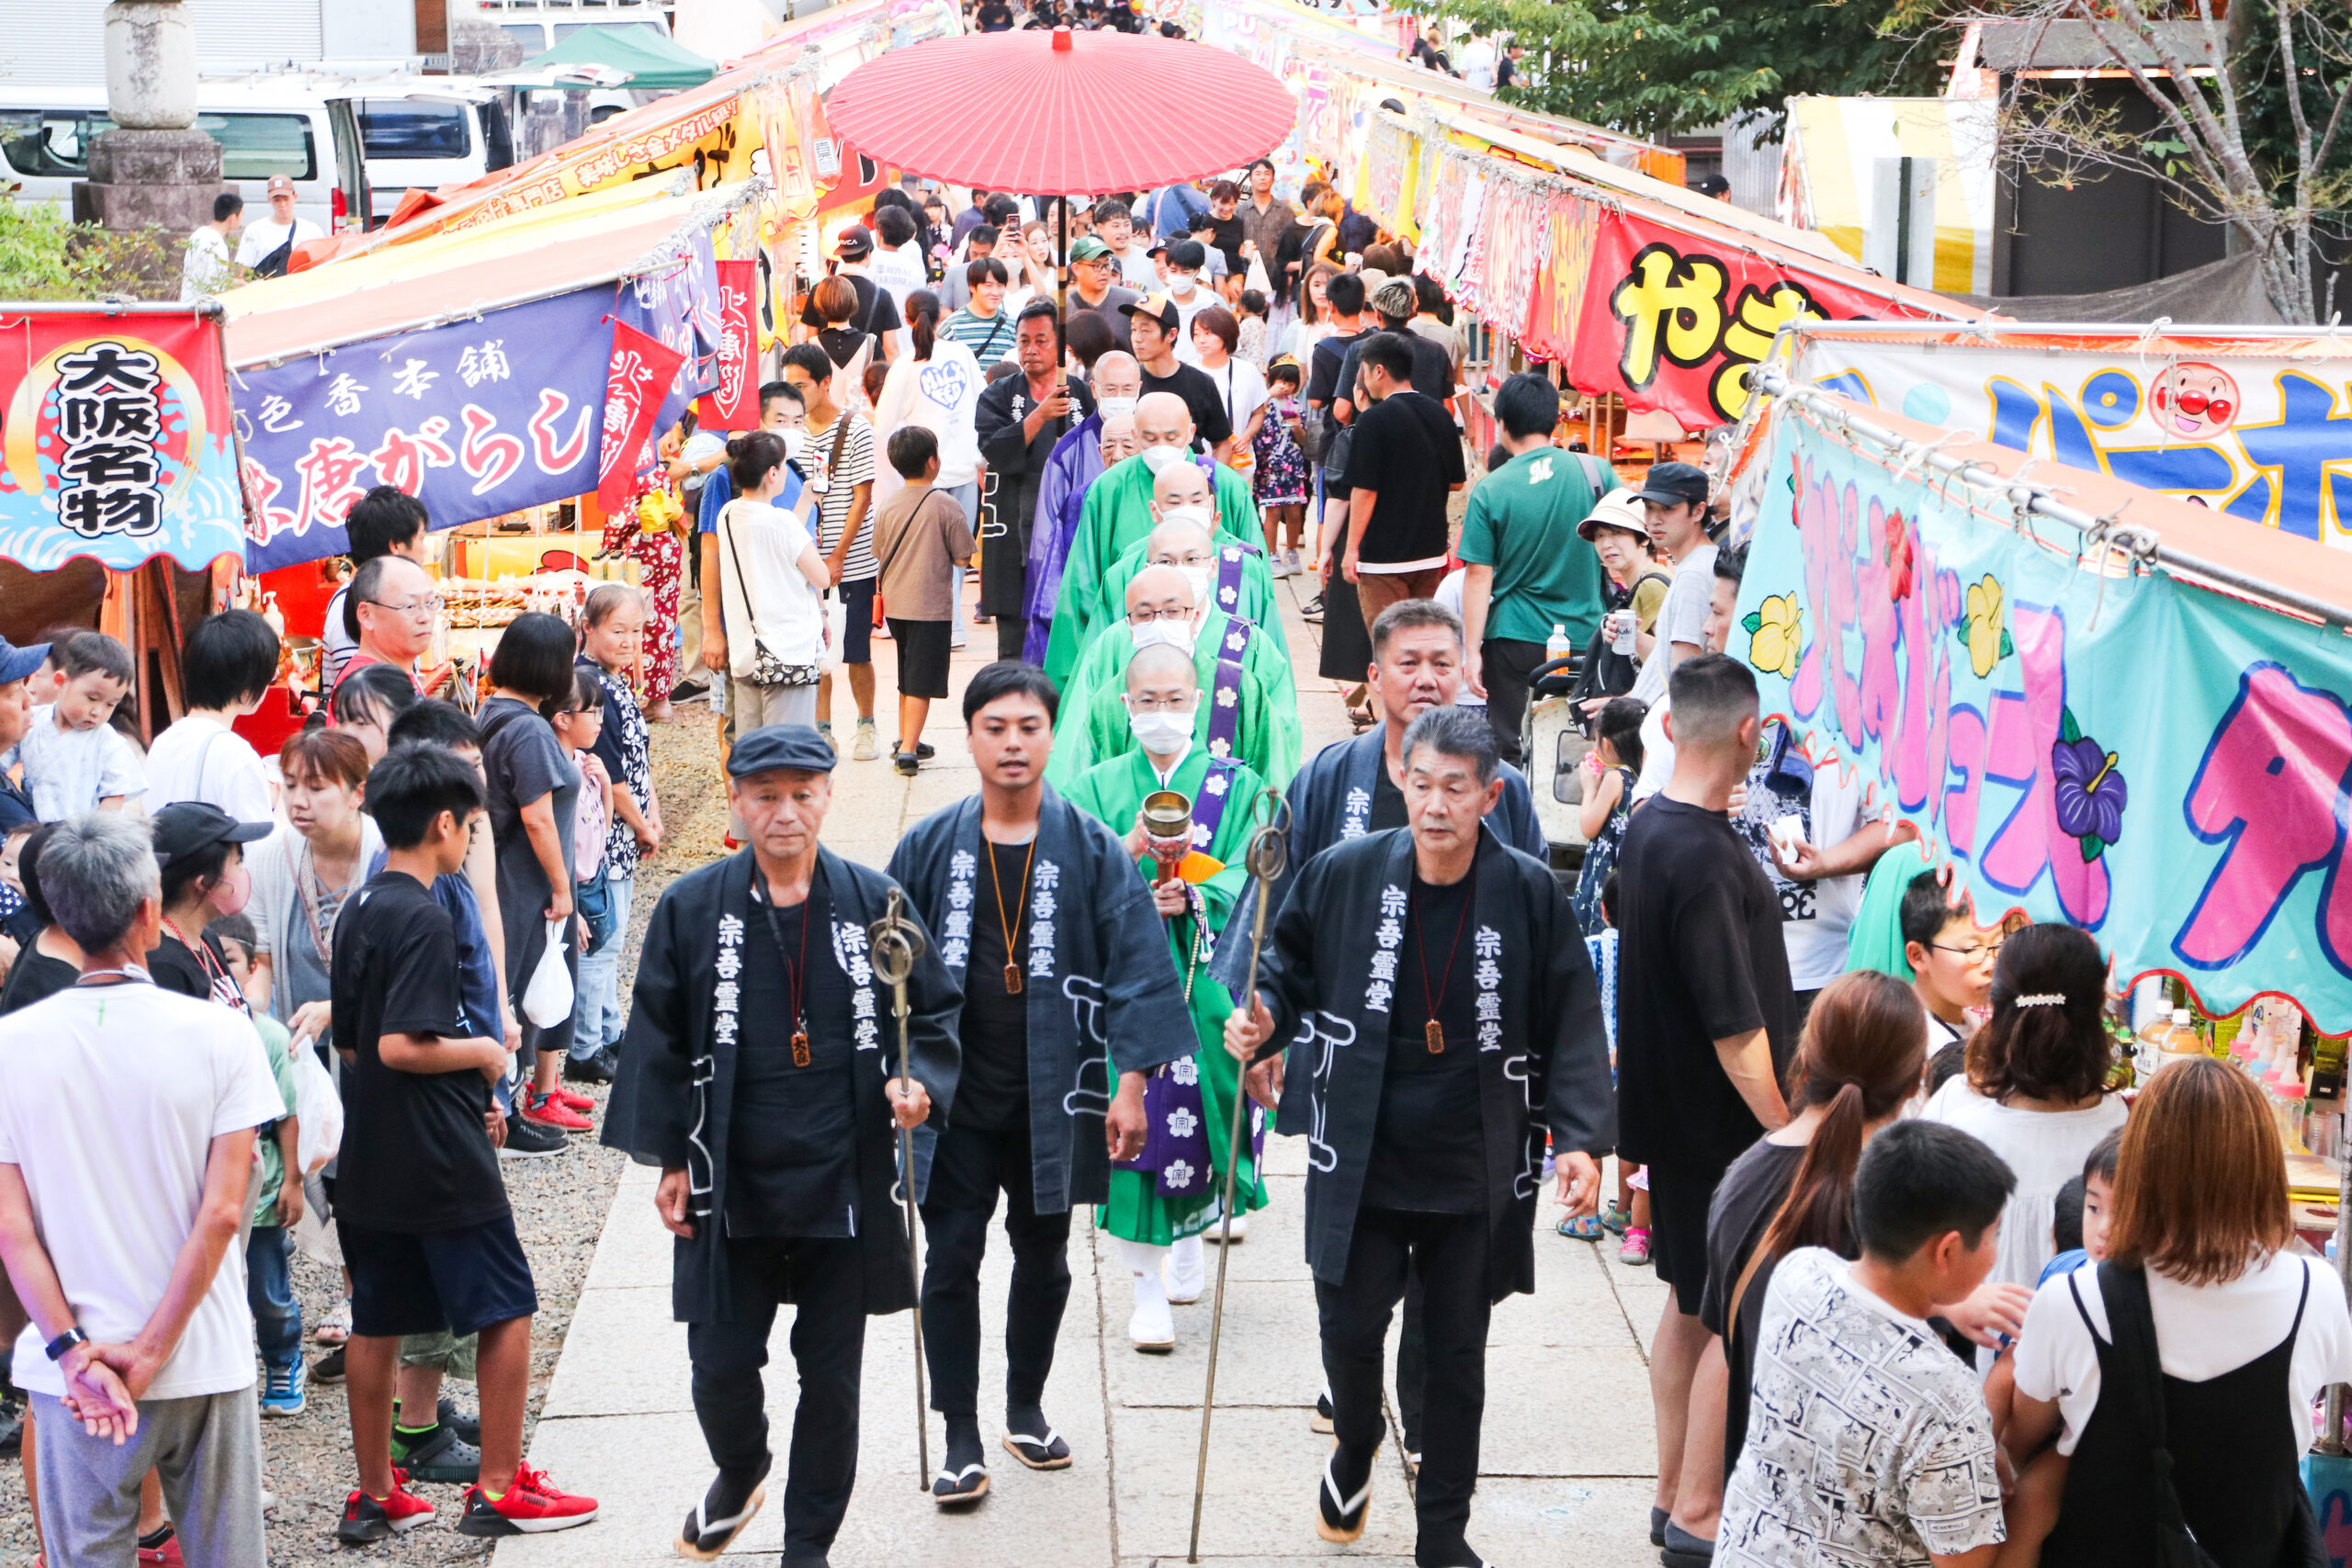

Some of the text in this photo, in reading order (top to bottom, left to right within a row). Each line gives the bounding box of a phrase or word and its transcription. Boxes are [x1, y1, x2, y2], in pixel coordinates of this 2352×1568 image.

[57, 343, 161, 537] 大阪名物
[258, 339, 511, 434] 色香本舗
[942, 850, 976, 967] 宗吾霊堂
[1028, 859, 1060, 977] 宗吾霊堂
[1364, 883, 1408, 1013] 宗吾霊堂
[714, 913, 745, 1045] 宗吾霊堂
[841, 921, 878, 1051] 宗吾霊堂
[1473, 924, 1503, 1053] 宗吾霊堂
